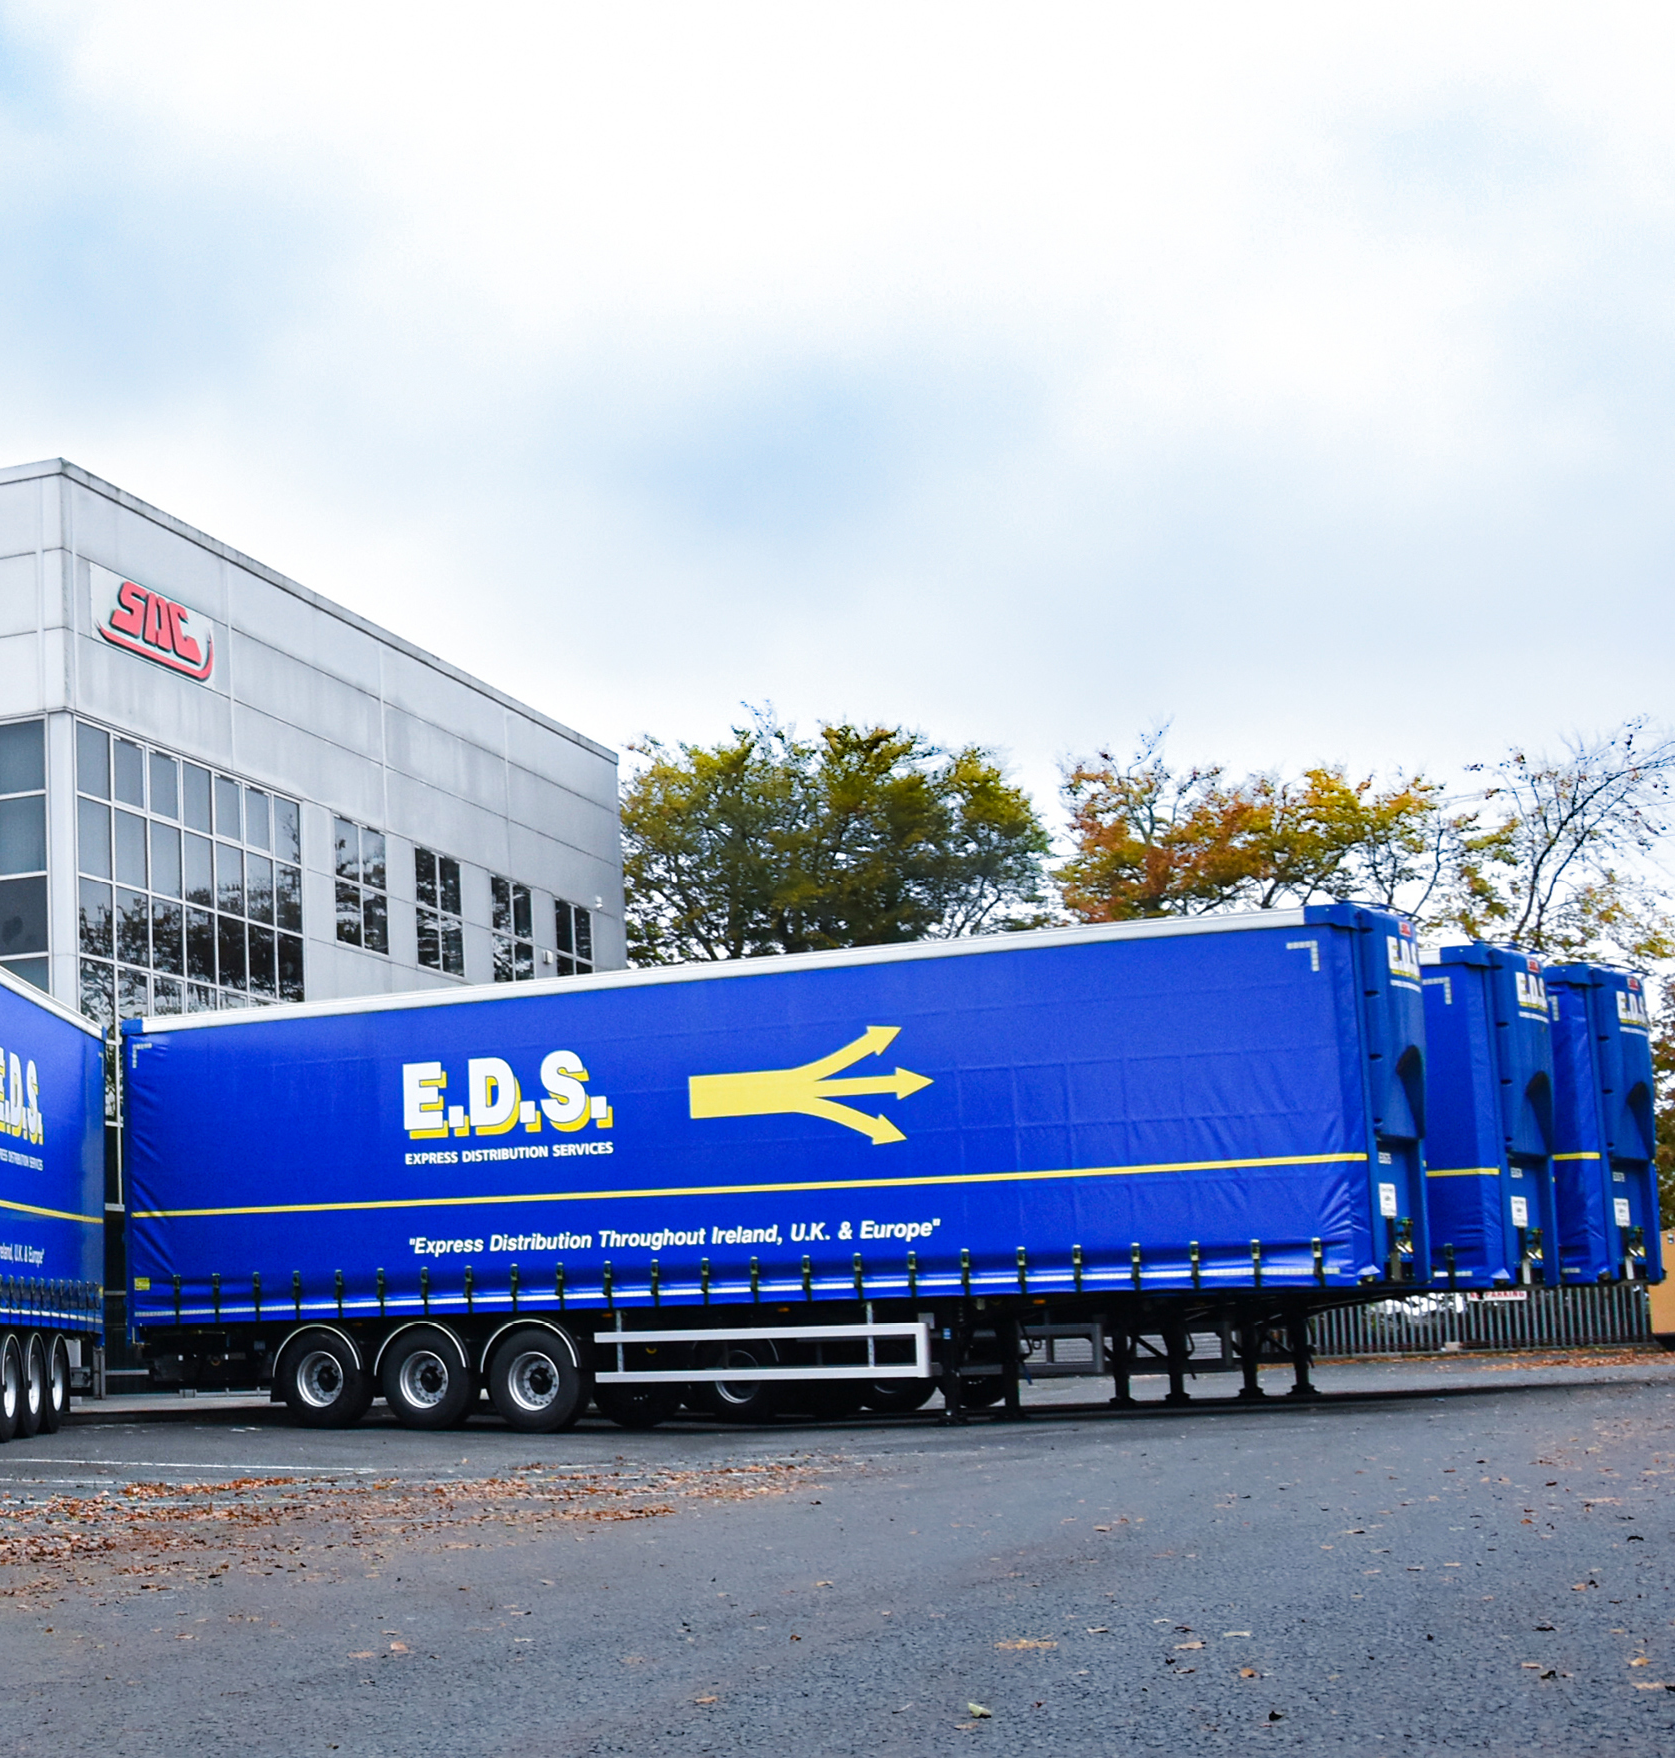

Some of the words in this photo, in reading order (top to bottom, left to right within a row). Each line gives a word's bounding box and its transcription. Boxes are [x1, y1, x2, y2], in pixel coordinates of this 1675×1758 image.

[109, 581, 204, 666] SDC
[402, 1049, 614, 1140] E.D.S.
[404, 1151, 459, 1166] EXPRESS
[461, 1146, 549, 1163] DISTRIBUTION
[552, 1141, 614, 1157] SERVICES
[408, 1236, 484, 1258] "Express
[489, 1231, 592, 1252] Distribution
[598, 1227, 706, 1251] Throughout
[711, 1223, 783, 1246] Ireland,
[790, 1222, 831, 1242] U.K.
[837, 1221, 853, 1240] &
[859, 1218, 941, 1243] Europe"
